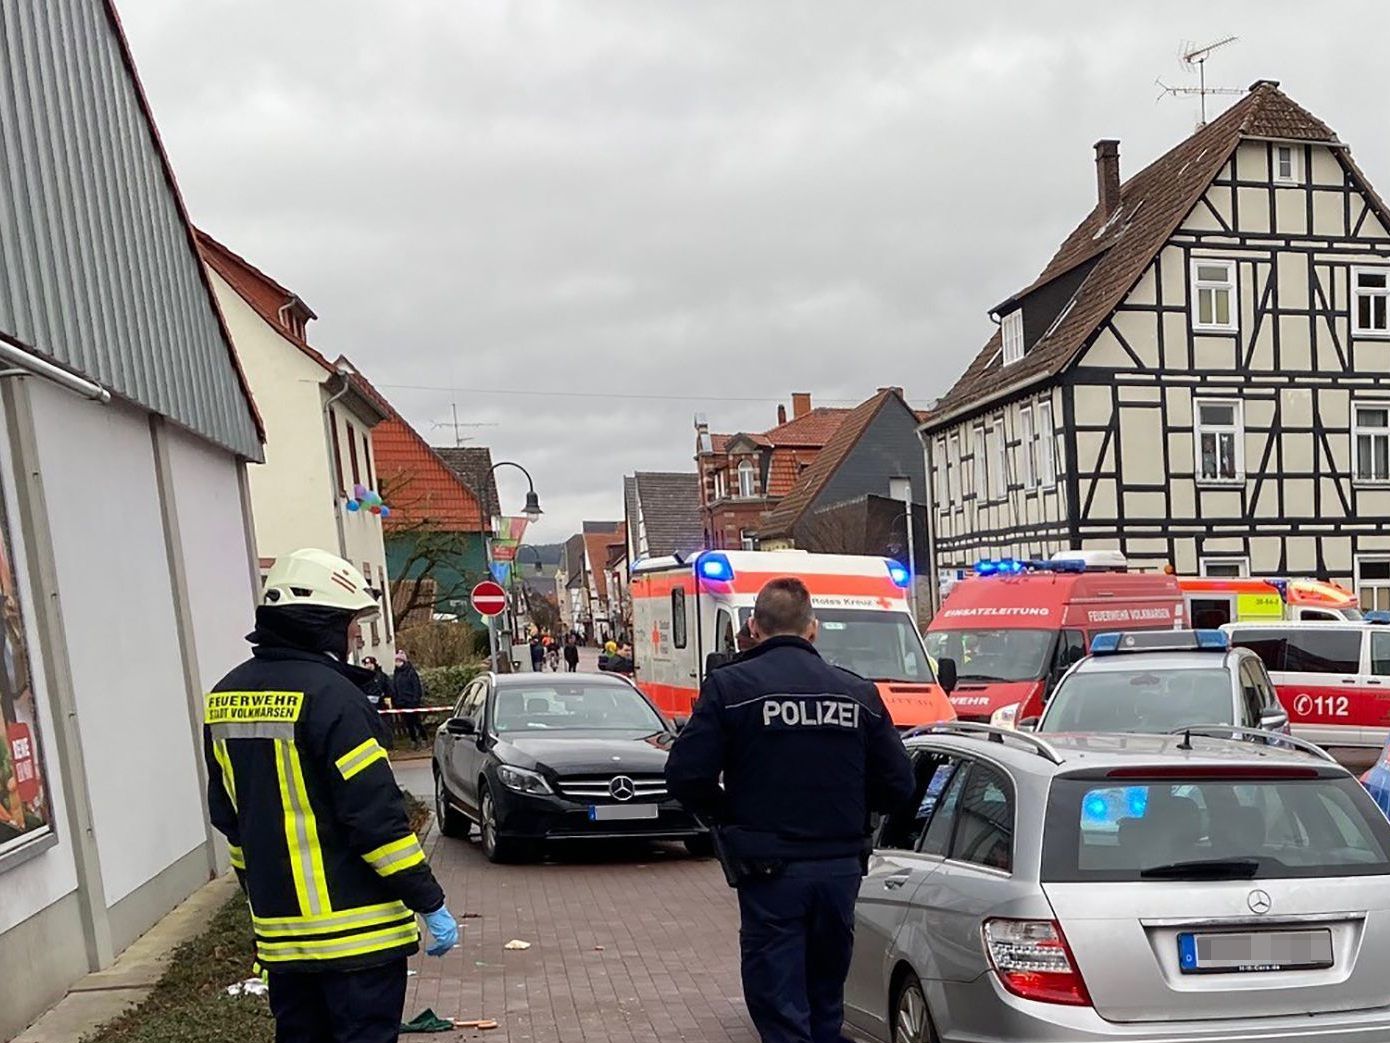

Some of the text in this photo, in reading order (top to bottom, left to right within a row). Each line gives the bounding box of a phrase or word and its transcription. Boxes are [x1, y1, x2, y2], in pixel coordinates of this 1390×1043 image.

[944, 606, 1050, 618] EINSATZLEITUNG
[208, 694, 299, 708] FEUERWEHR
[1314, 696, 1349, 716] 112
[230, 707, 295, 719] VOLKMARSEN
[762, 700, 860, 729] POLIZEI
